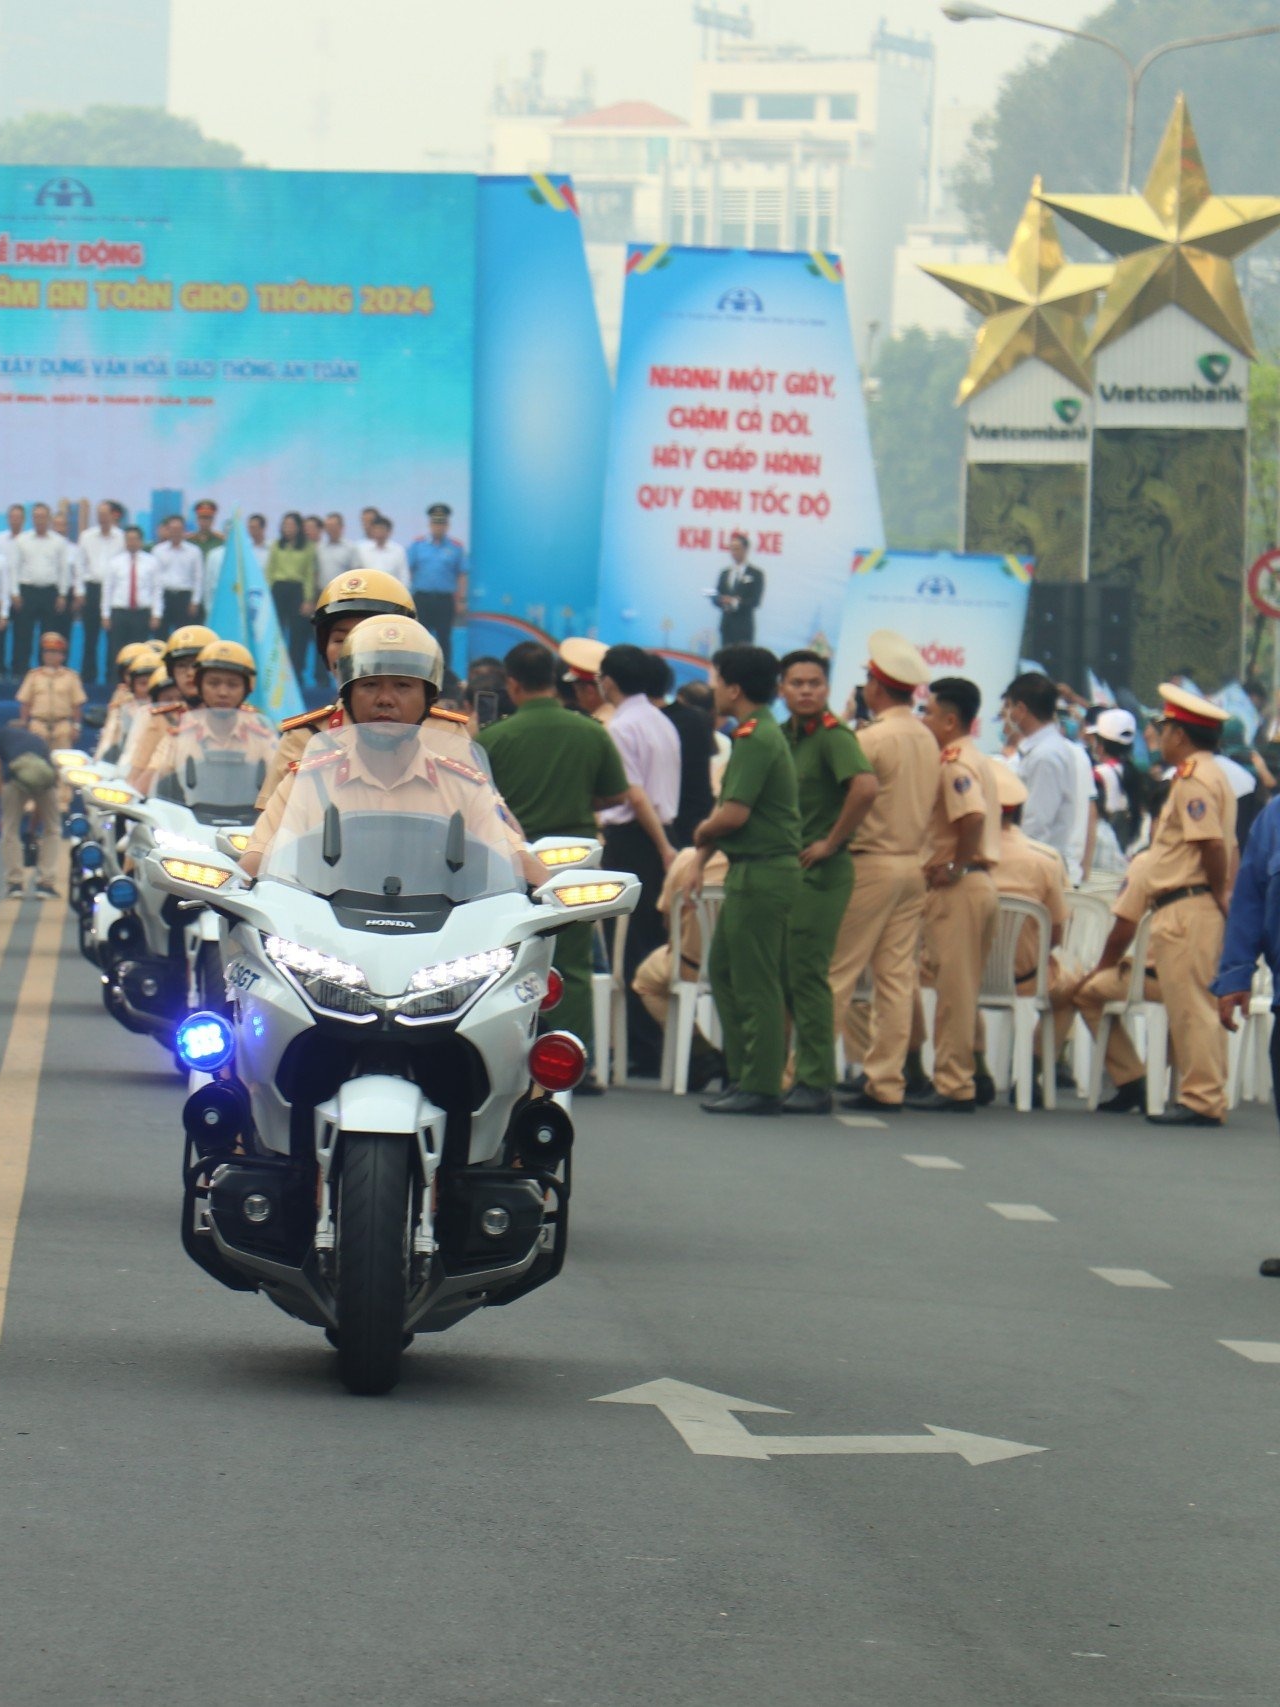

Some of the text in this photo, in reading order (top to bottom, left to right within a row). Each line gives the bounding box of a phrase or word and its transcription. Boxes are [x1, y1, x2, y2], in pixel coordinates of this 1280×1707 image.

[15, 238, 70, 264] PHÁT
[77, 237, 143, 269] ĐỘNG
[47, 280, 88, 310] AN
[94, 276, 172, 311] TOÀN
[180, 282, 248, 313] GIAO
[255, 279, 353, 315] THÔNG
[359, 286, 434, 315] 2024
[649, 365, 836, 398] NHANH MỘT GIÂY,
[1100, 384, 1242, 403] Vietcombank
[668, 403, 729, 435] CHẬM
[736, 404, 762, 432] CẢ
[652, 442, 822, 476] HÃY CHẤP HÀNH
[637, 484, 831, 523] QUY ĐỊNH TỐC ĐỘ
[678, 527, 712, 549] KHI
[757, 531, 783, 554] XE
[365, 919, 416, 928] HONDA
